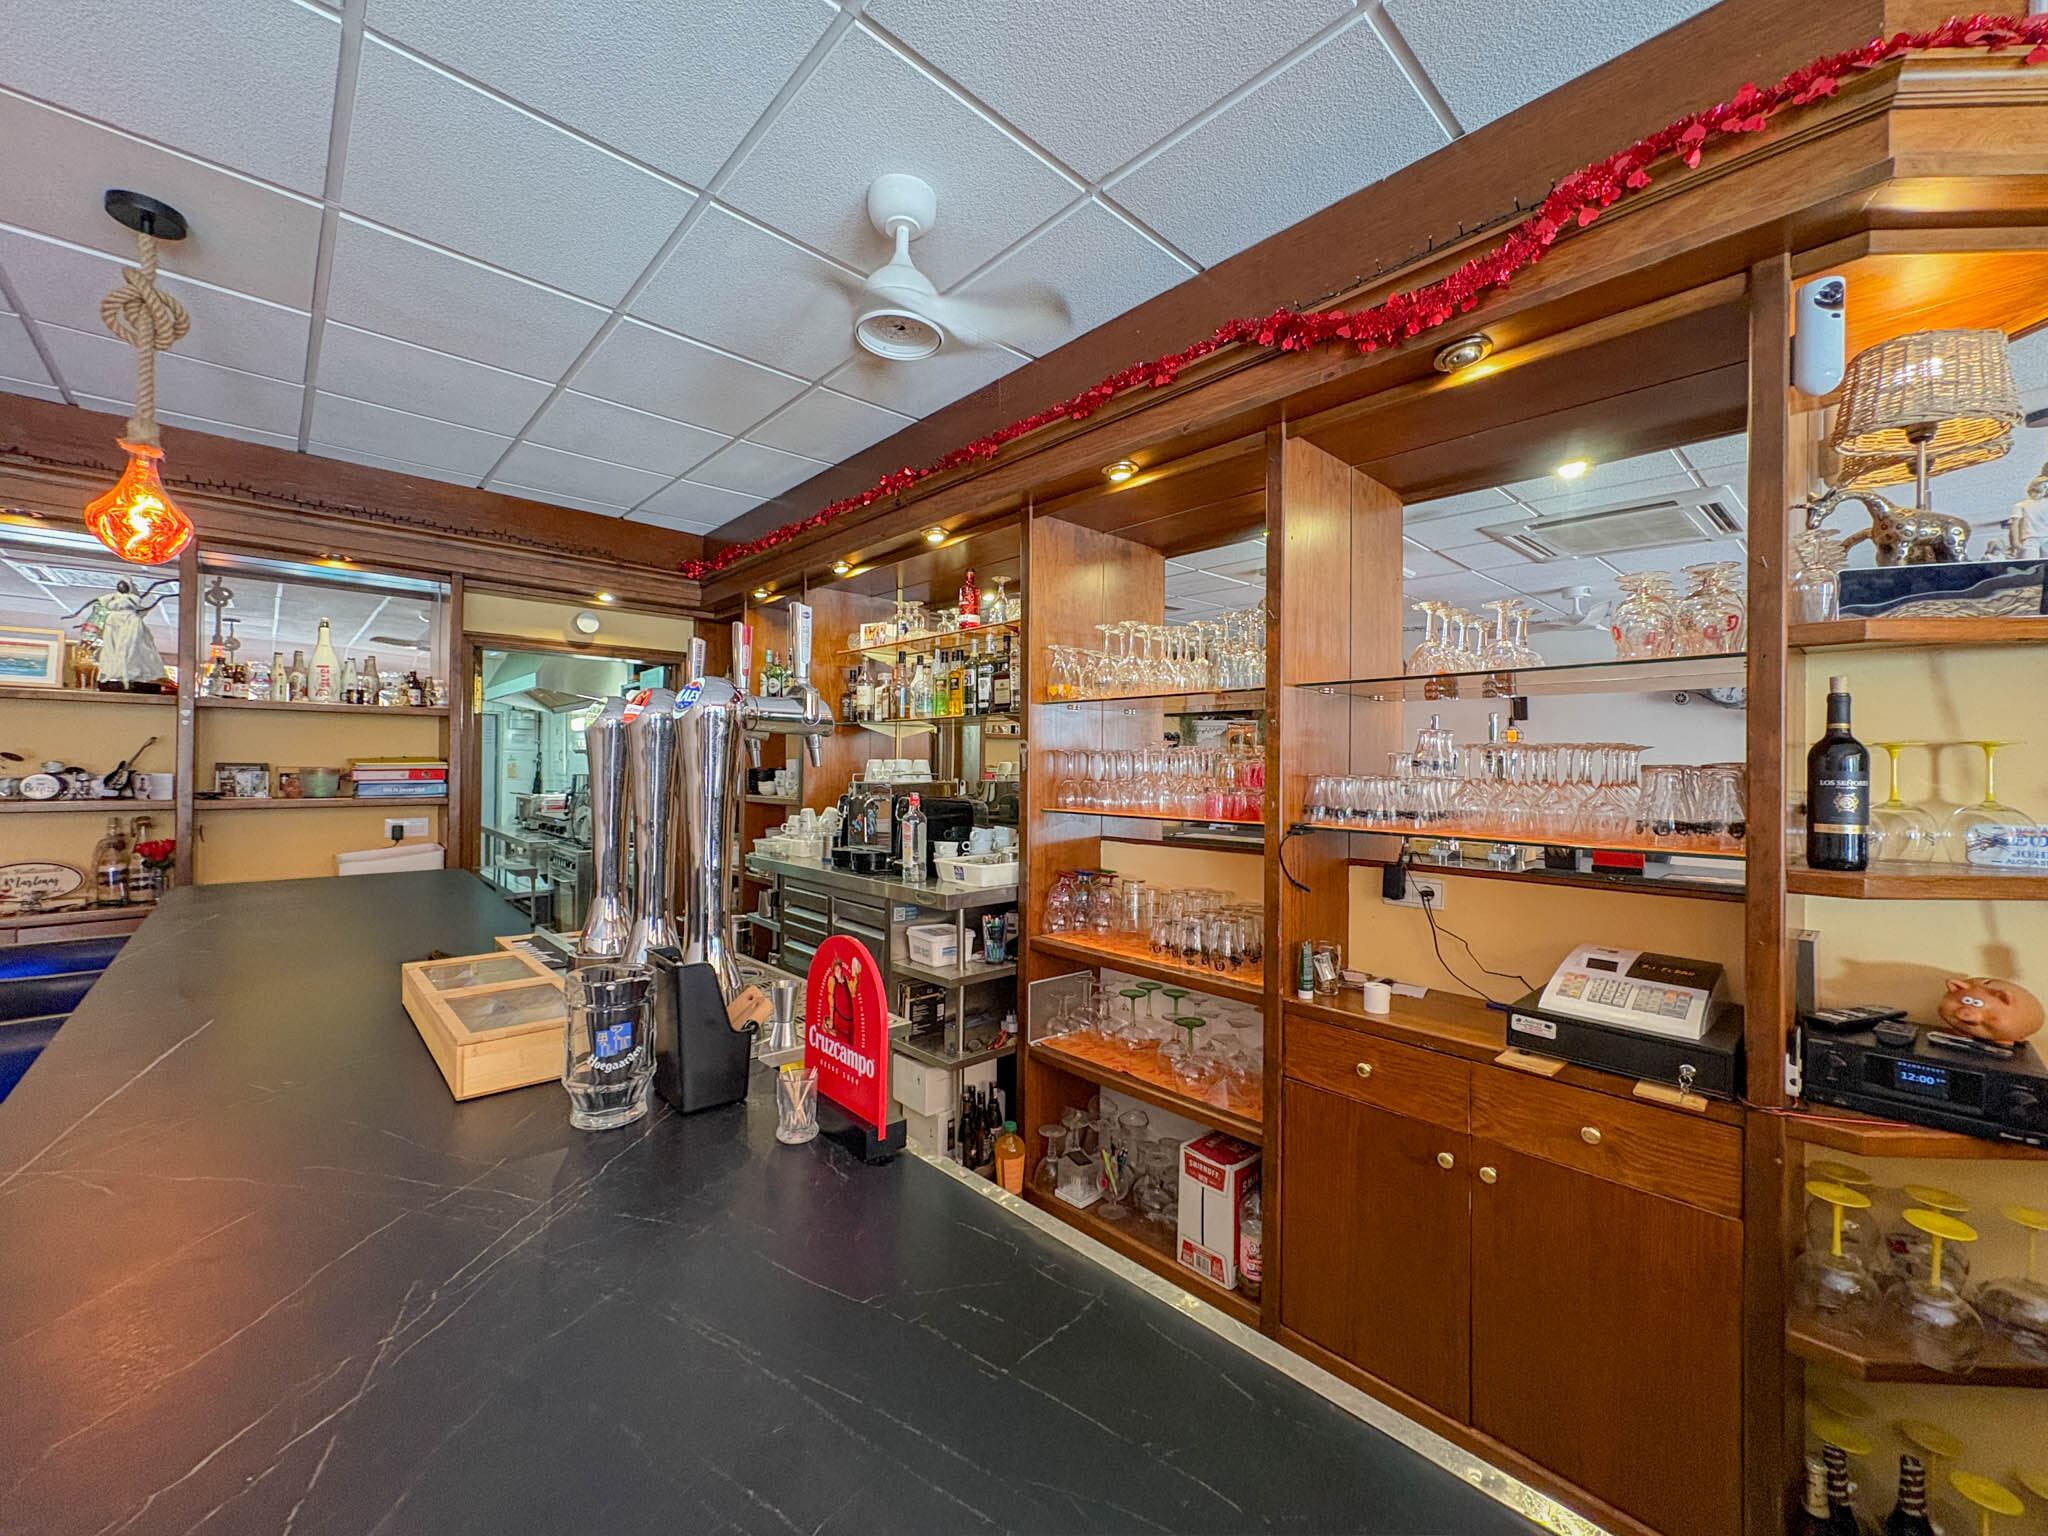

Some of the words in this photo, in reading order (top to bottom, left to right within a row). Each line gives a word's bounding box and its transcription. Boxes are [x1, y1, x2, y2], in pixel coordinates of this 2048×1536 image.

[586, 1045, 643, 1074] Hoegaarden
[808, 1024, 874, 1079] Cruzcampo
[1901, 1071, 1935, 1085] 12:00
[1188, 1158, 1221, 1180] SMIRNOFF
